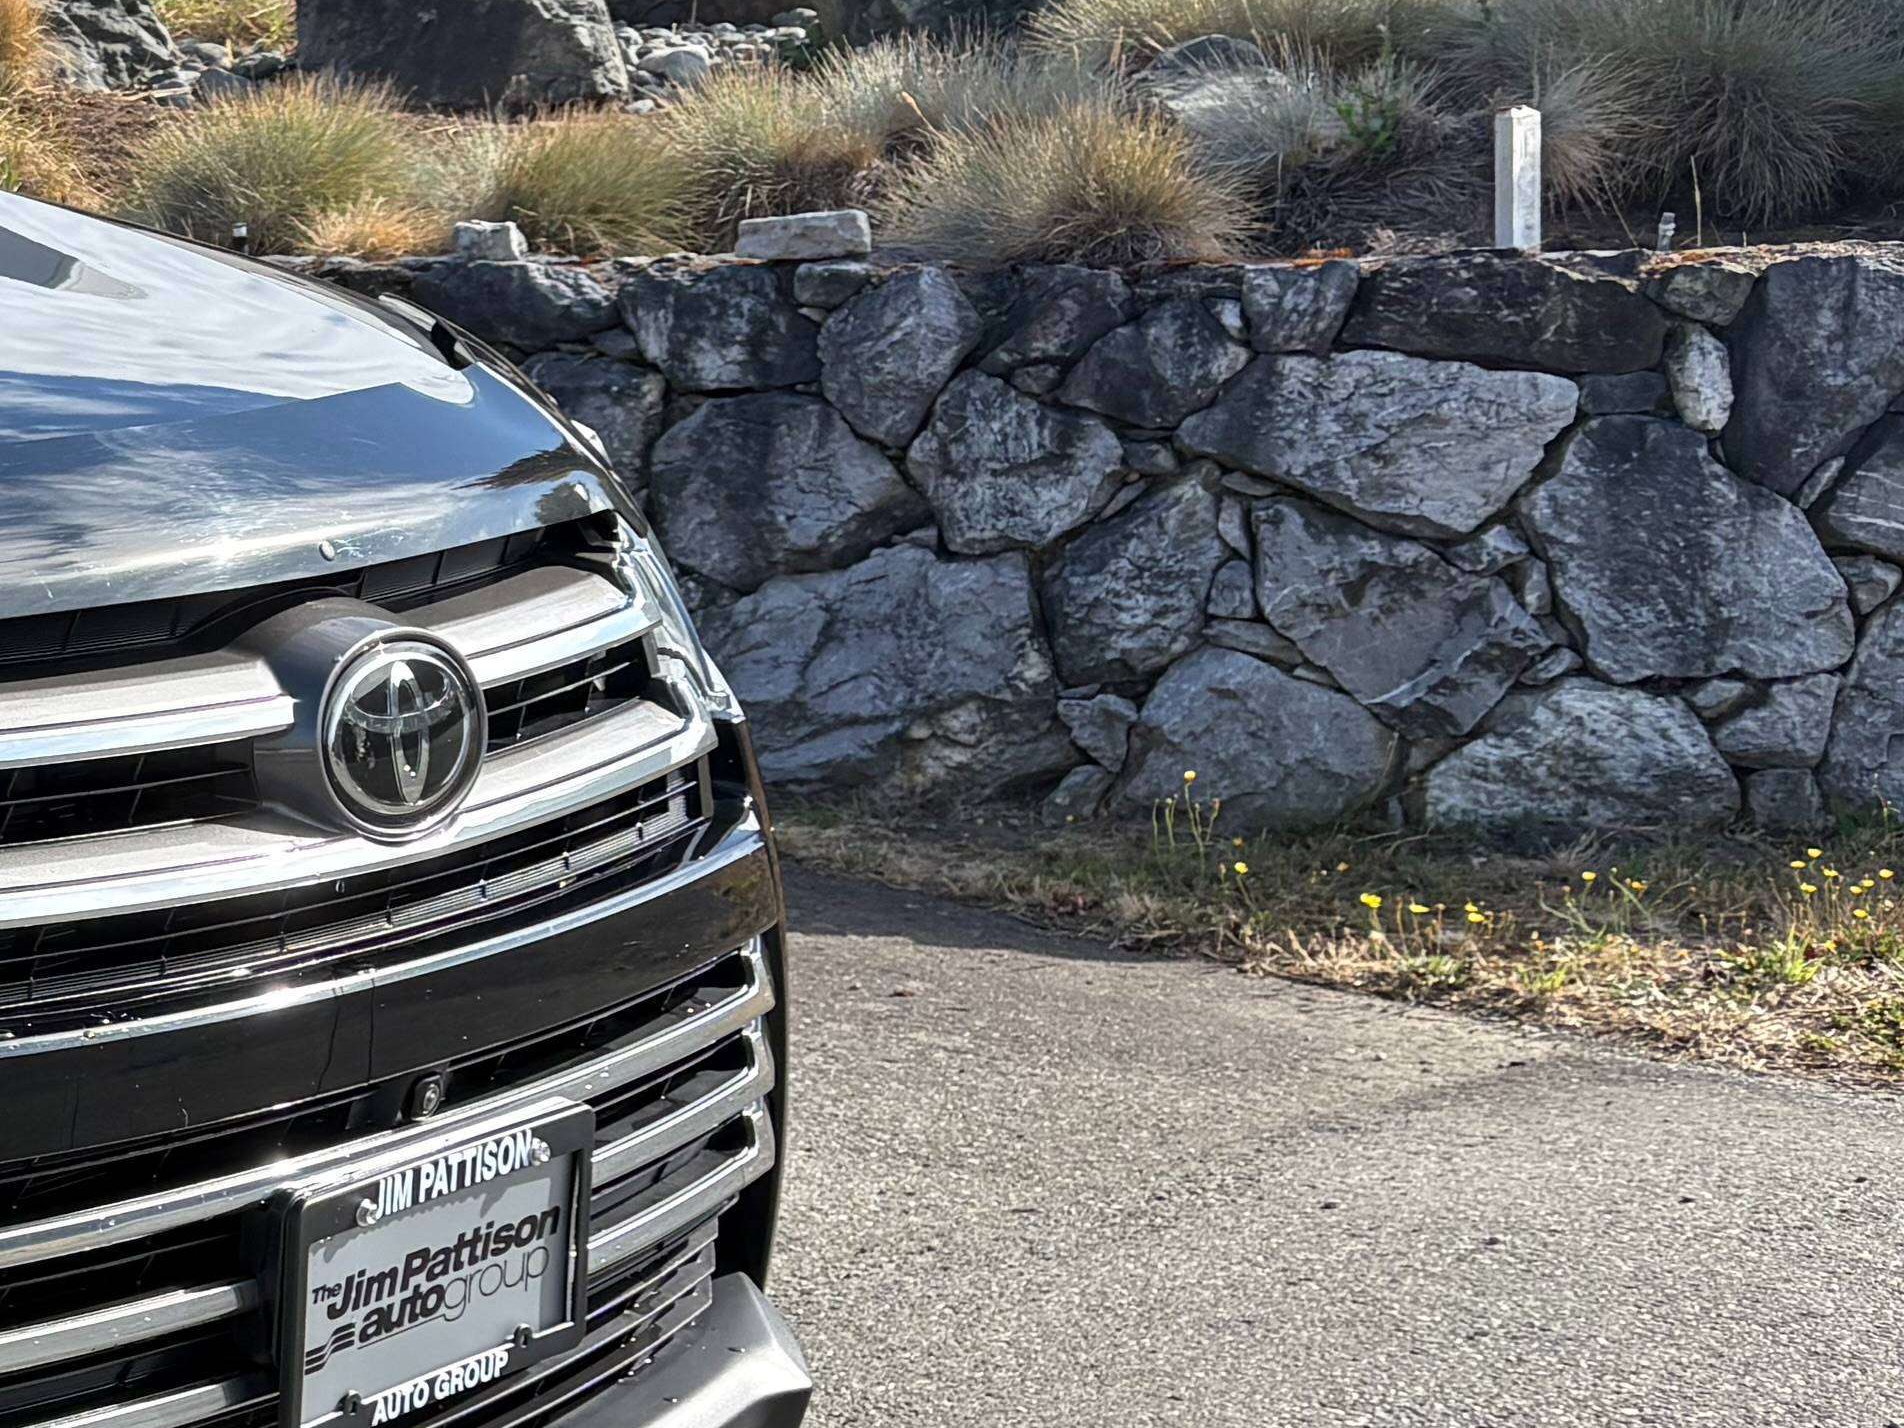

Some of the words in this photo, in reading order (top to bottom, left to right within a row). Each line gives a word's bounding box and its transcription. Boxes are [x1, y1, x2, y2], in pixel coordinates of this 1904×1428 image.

[375, 1170, 414, 1220] JIM
[419, 1127, 533, 1204] PATTISON
[399, 1204, 561, 1292] Pattison
[312, 1280, 341, 1305] The
[326, 1262, 402, 1321] Jim
[371, 1384, 430, 1427] AUTO
[434, 1349, 510, 1400] GROUP
